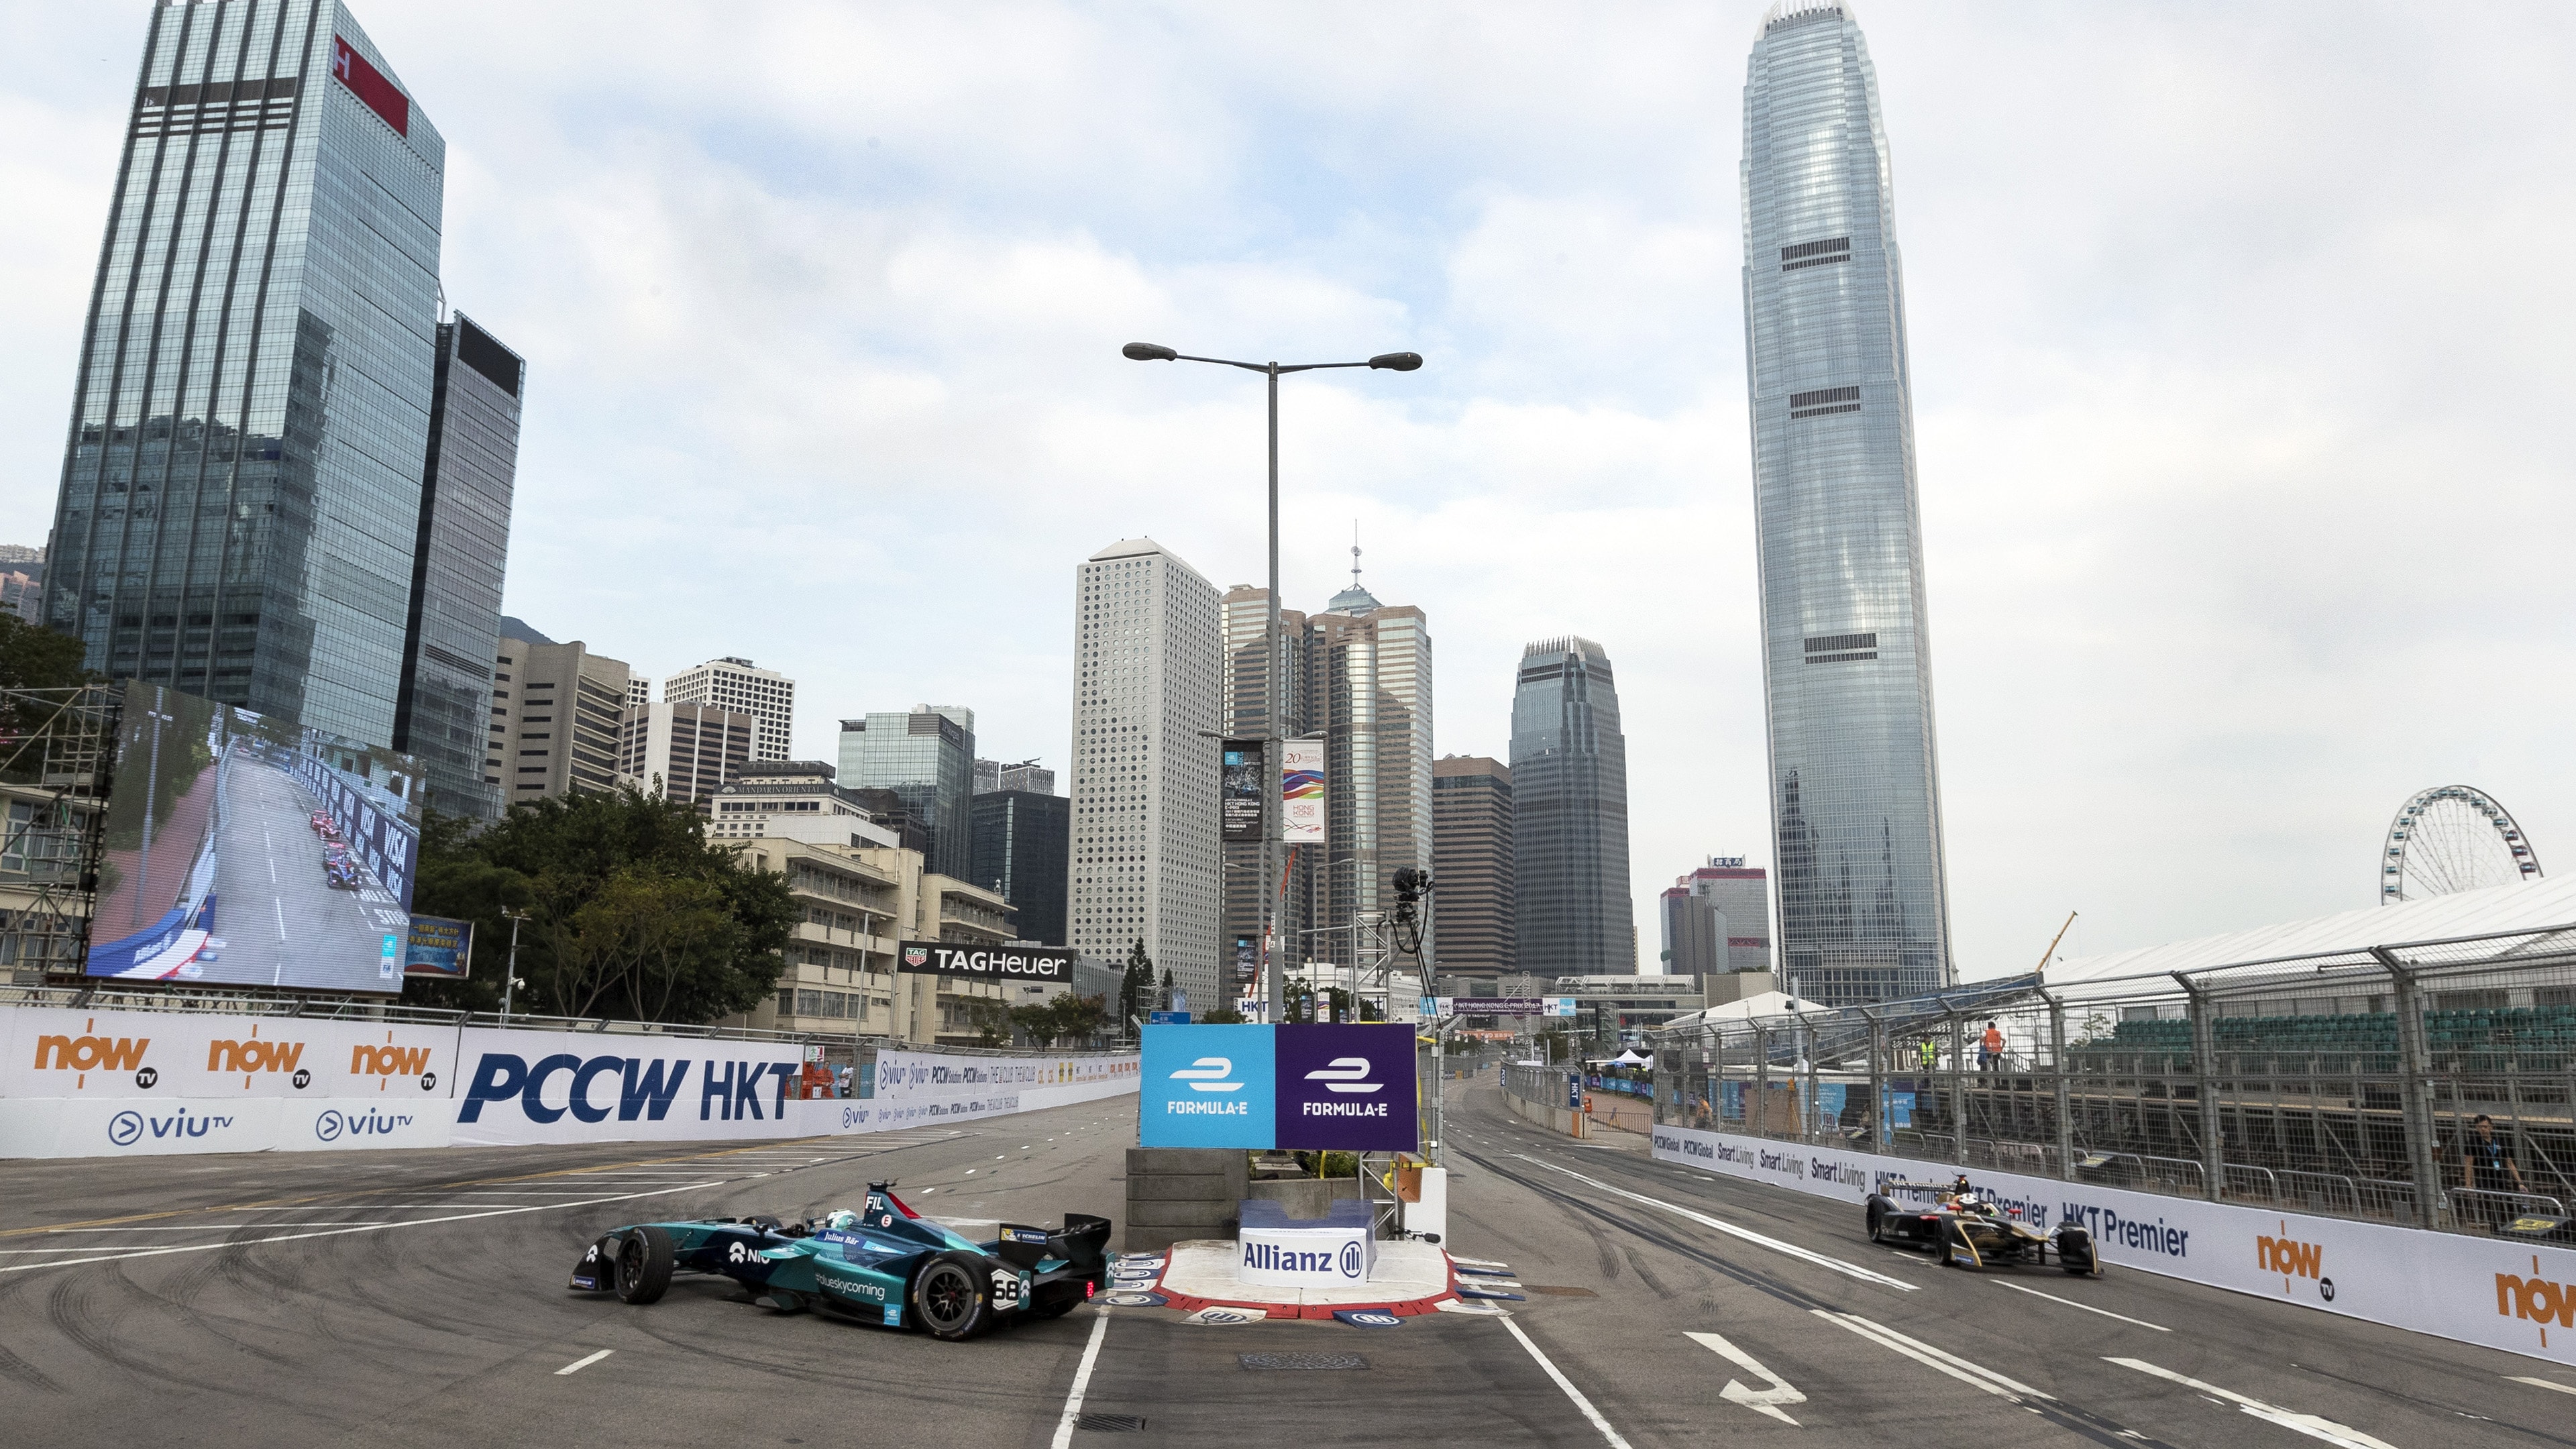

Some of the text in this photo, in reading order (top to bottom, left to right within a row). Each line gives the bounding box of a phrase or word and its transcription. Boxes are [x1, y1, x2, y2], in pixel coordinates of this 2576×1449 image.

[1285, 753, 1301, 764] 20
[738, 786, 820, 794] MANDARIN ORIENTAL
[384, 820, 408, 873] VISA
[906, 955, 926, 965] HEUER
[908, 948, 925, 956] TAG
[935, 949, 1067, 975] TAGHeuer
[138, 1072, 156, 1085] TV
[294, 1073, 309, 1085] TV
[422, 1077, 435, 1087] TV
[932, 1065, 949, 1084] PCCW
[963, 1067, 977, 1084] PCCW
[457, 1053, 799, 1124] PCCW HKT
[1167, 1101, 1248, 1115] FORMULA-E
[1303, 1102, 1388, 1116] FORMULA-E
[1654, 1135, 1680, 1152] PCCW Global
[1684, 1140, 1713, 1159] PCCW Global
[1718, 1142, 1754, 1169] Smart Living
[1760, 1149, 1803, 1180] Smart Living
[1811, 1157, 1866, 1193] Smart Living
[865, 1196, 883, 1210] FIL
[883, 1216, 890, 1225] E
[2063, 1202, 2188, 1257] HKT Premier
[824, 1232, 859, 1245] Julius Bär
[1244, 1242, 1332, 1272] Allianz
[815, 1272, 885, 1301] #blueskycoming
[994, 1279, 1019, 1301] 68
[2321, 1283, 2333, 1295] TV
